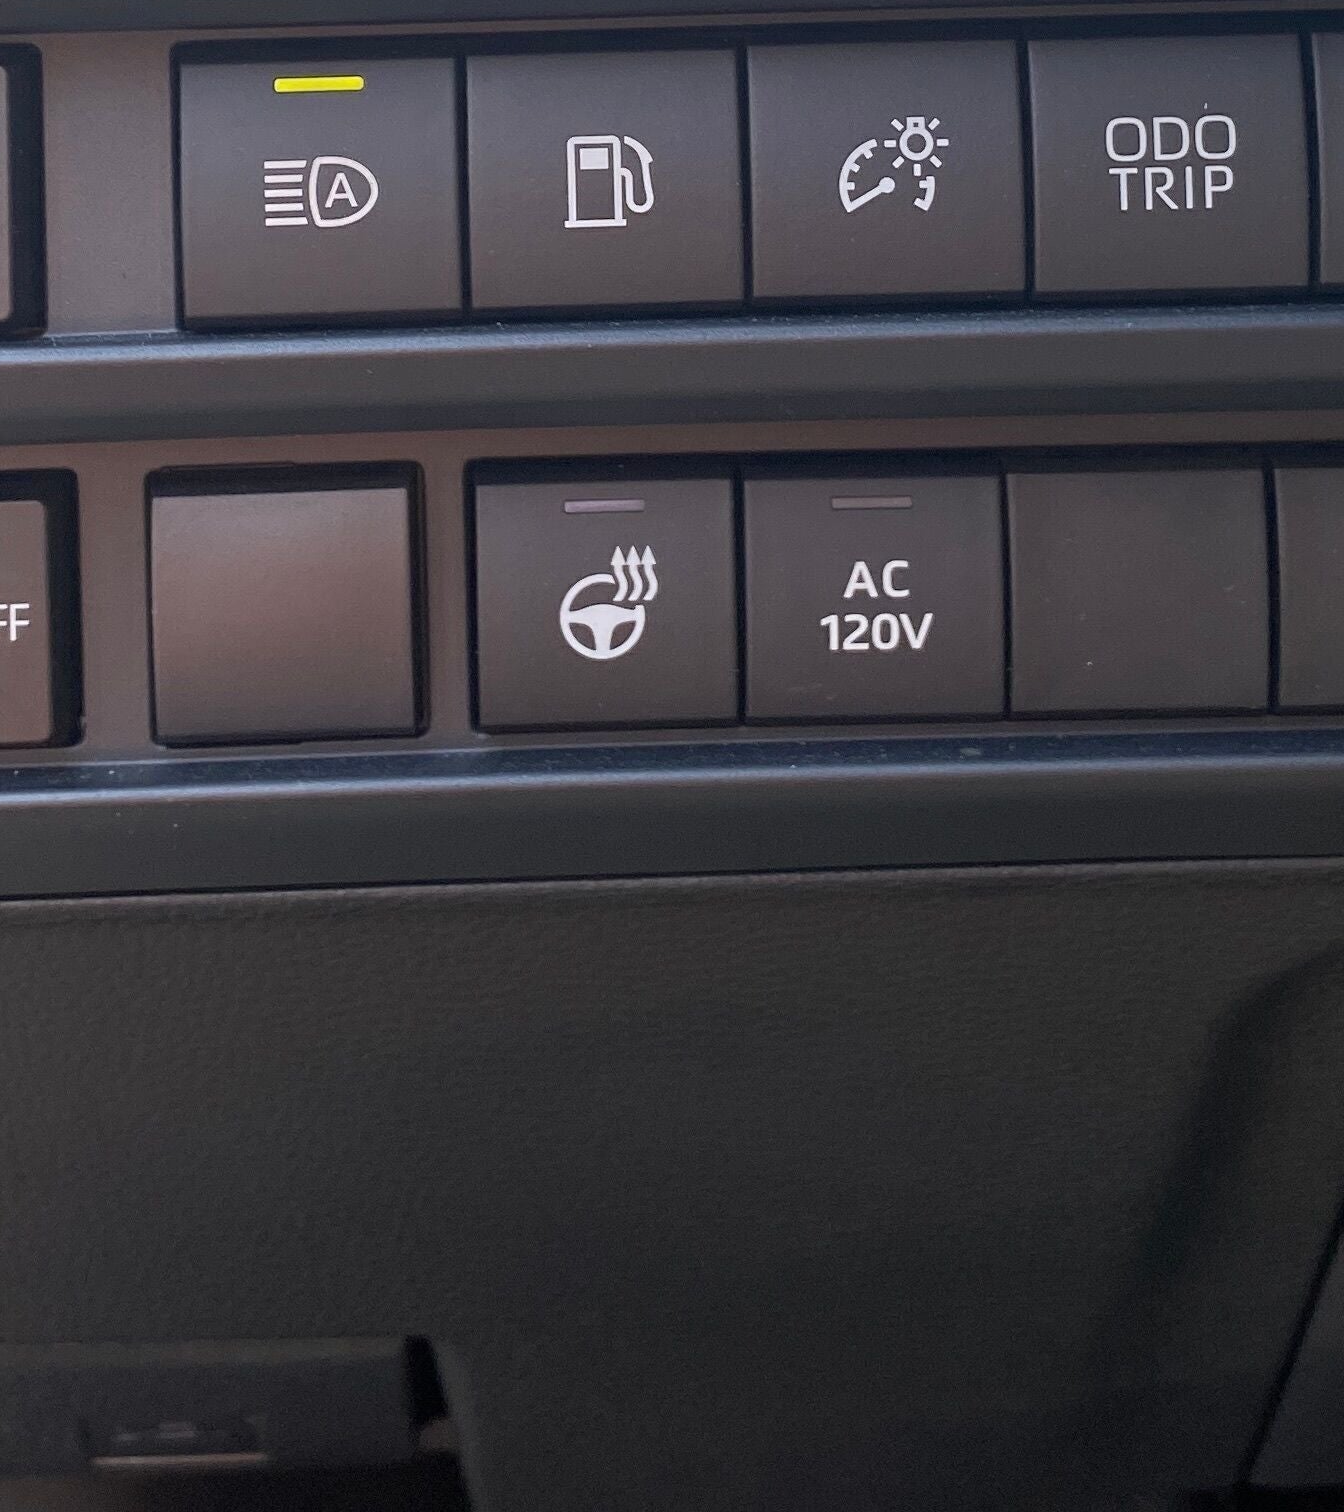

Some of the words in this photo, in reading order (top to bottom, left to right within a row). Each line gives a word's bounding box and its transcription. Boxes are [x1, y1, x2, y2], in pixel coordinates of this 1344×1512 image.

[1105, 114, 1237, 162] ODO
[324, 173, 359, 208] A
[1108, 165, 1234, 211] TRIP
[843, 559, 910, 599] AC
[820, 612, 934, 651] 120V
